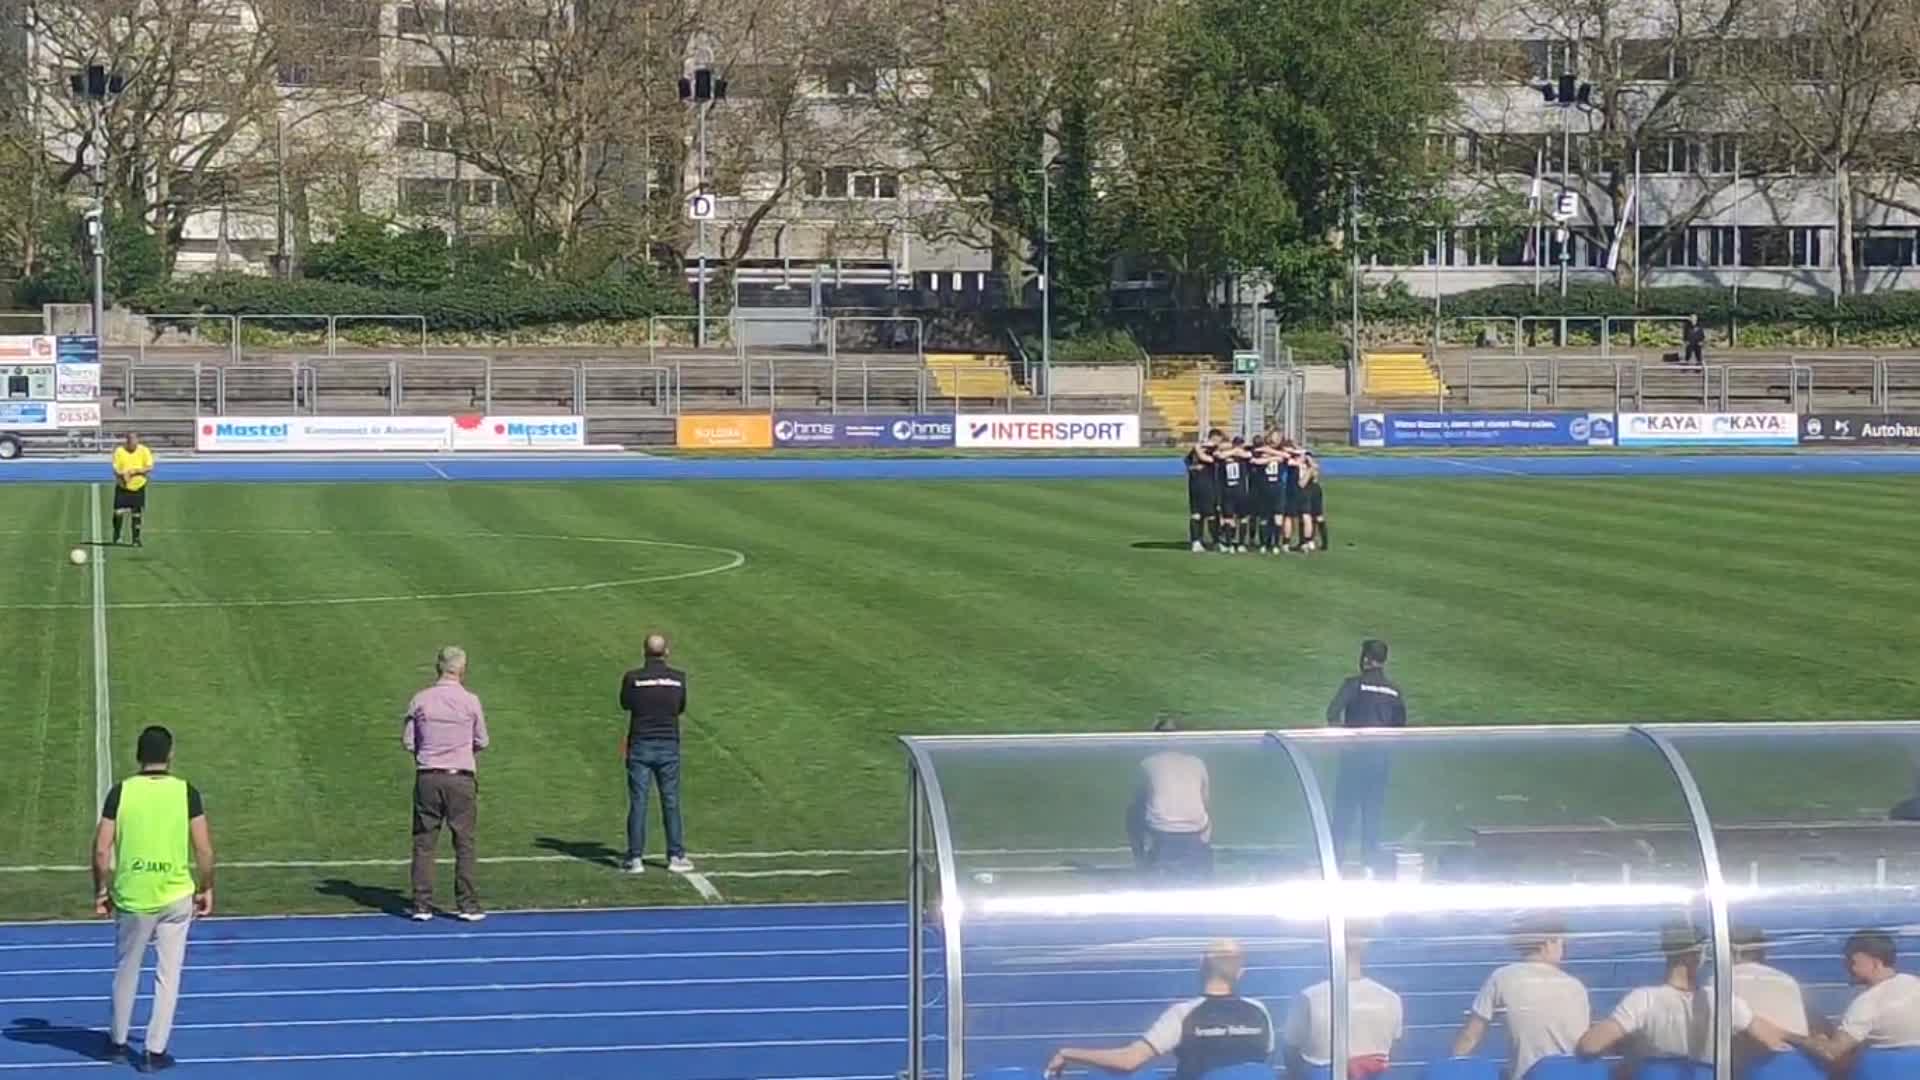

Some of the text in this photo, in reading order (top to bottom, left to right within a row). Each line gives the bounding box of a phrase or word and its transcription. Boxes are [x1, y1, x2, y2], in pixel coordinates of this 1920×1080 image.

[694, 197, 710, 216] D
[1557, 194, 1573, 215] E
[216, 423, 288, 436] Mastel
[508, 422, 577, 436] Mastel
[793, 420, 835, 434] hms
[911, 421, 952, 434] hms
[1647, 416, 1697, 430] KAYA
[1730, 416, 1780, 430] KAYA
[991, 422, 1125, 440] INTERSPORT
